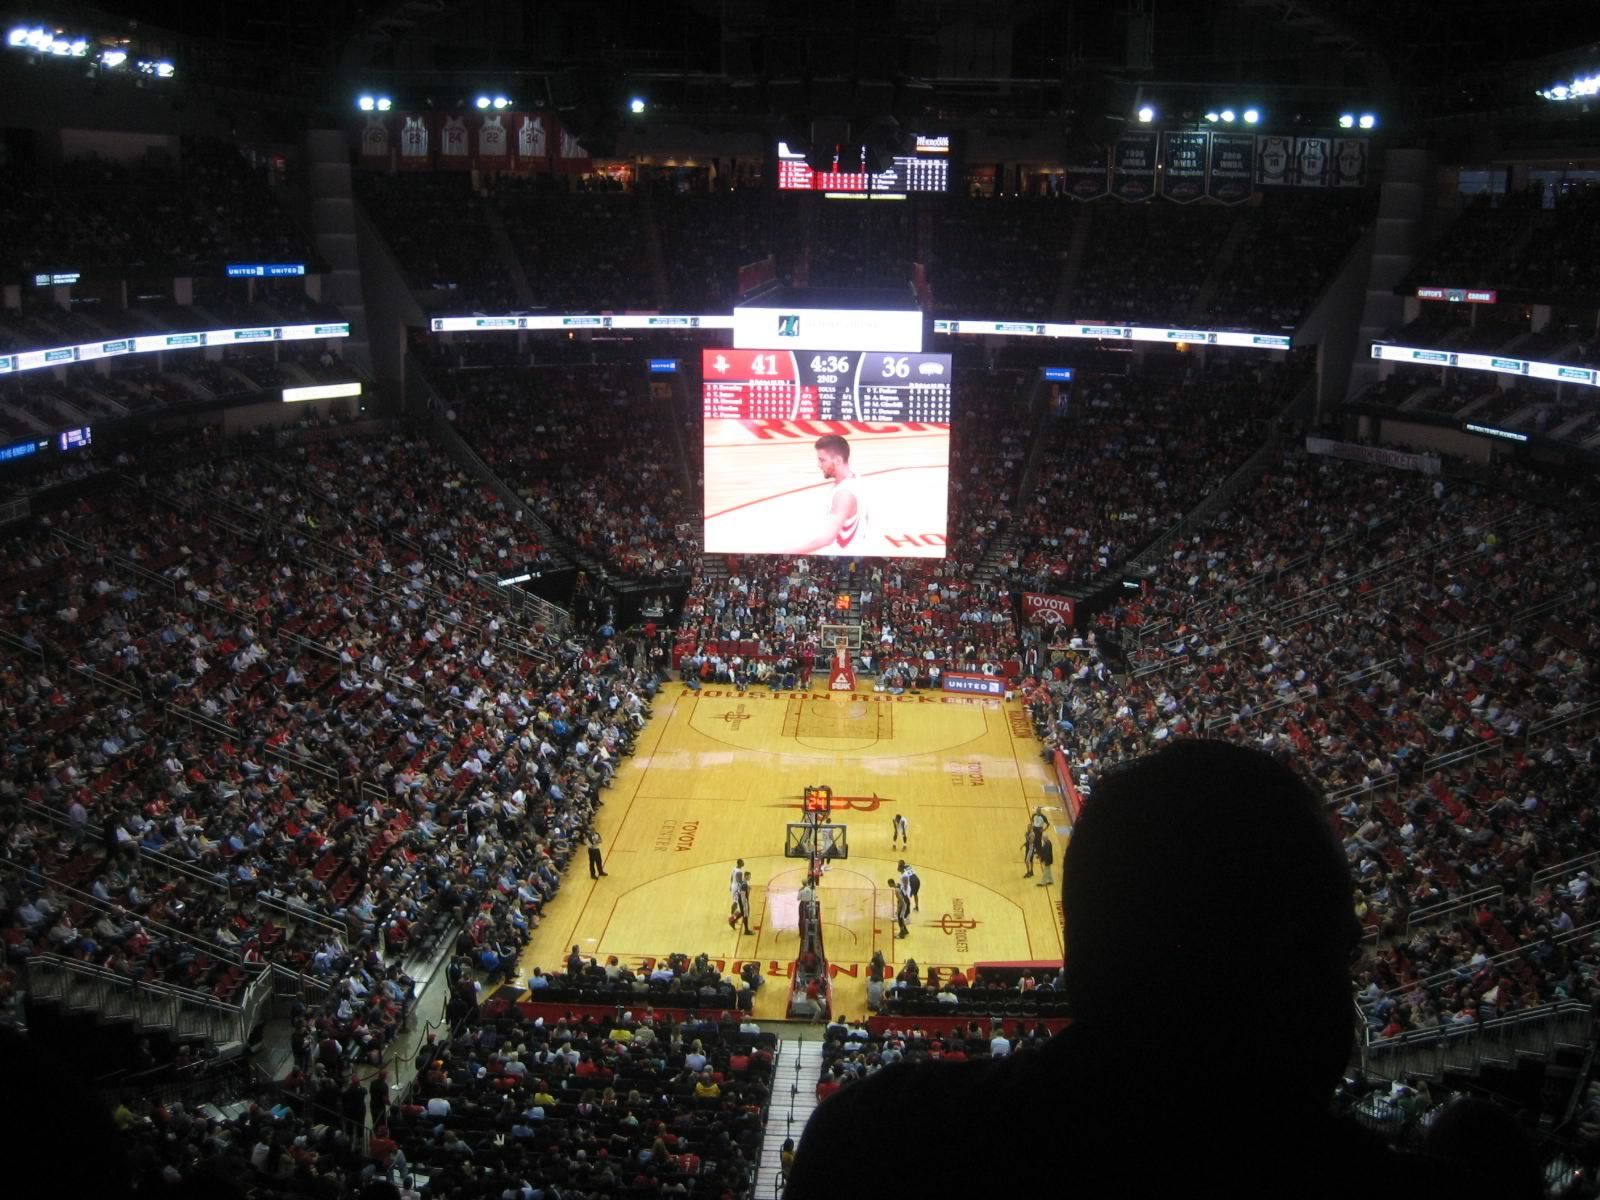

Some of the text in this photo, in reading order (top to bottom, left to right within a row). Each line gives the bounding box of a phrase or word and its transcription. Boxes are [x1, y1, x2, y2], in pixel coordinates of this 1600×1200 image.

[409, 133, 420, 144] 23
[486, 132, 499, 143] 22
[526, 133, 538, 144] 34
[751, 354, 779, 375] 41
[810, 355, 849, 373] 4:36
[882, 356, 910, 378] 36
[817, 375, 838, 384] 2ND
[1376, 450, 1418, 465] ROCKETS
[1026, 595, 1070, 612] TOYOTA
[832, 682, 851, 690] PEAK
[949, 681, 987, 691] UNITED
[681, 690, 831, 700] HOUSTON
[808, 797, 826, 810] 24
[653, 819, 678, 852] CENTER
[674, 820, 700, 852] TOYOTA
